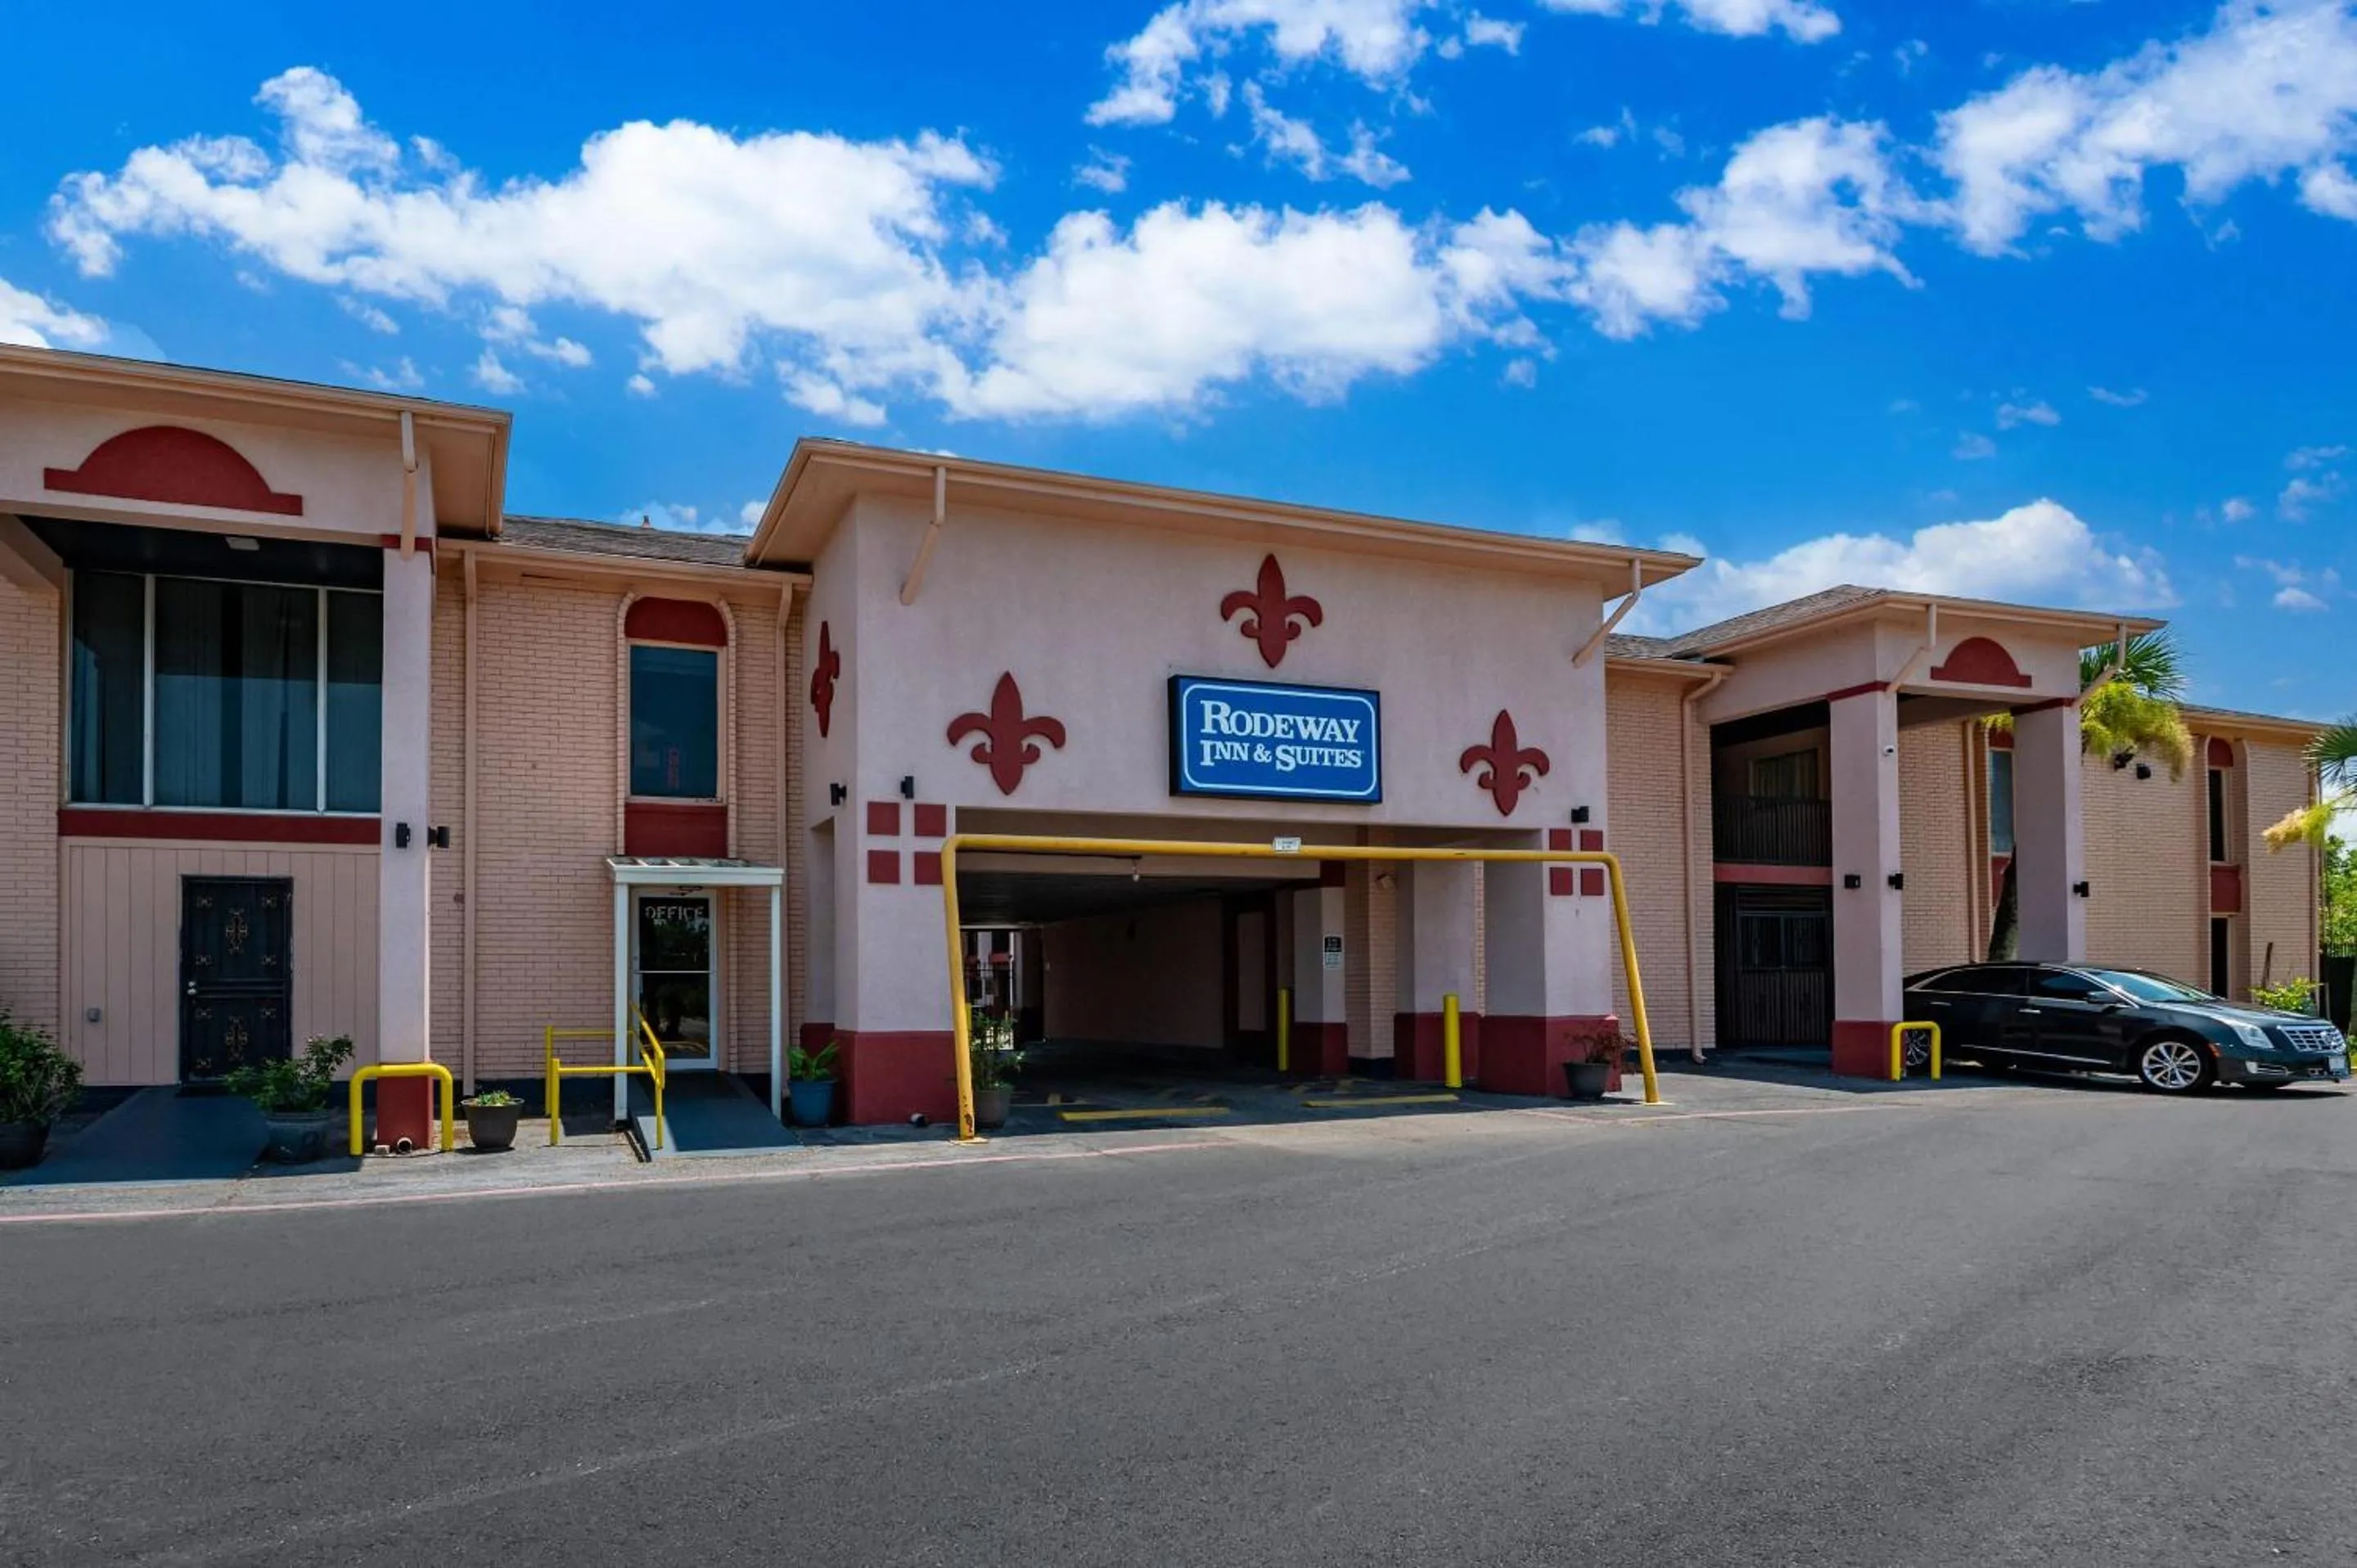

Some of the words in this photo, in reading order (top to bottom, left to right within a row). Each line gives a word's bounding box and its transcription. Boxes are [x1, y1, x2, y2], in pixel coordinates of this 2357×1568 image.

[1200, 700, 1361, 743] RODEWAY
[1200, 740, 1249, 766] INN
[1253, 743, 1272, 763] &
[1275, 745, 1362, 771] SUITES
[645, 905, 705, 921] OFFICE
